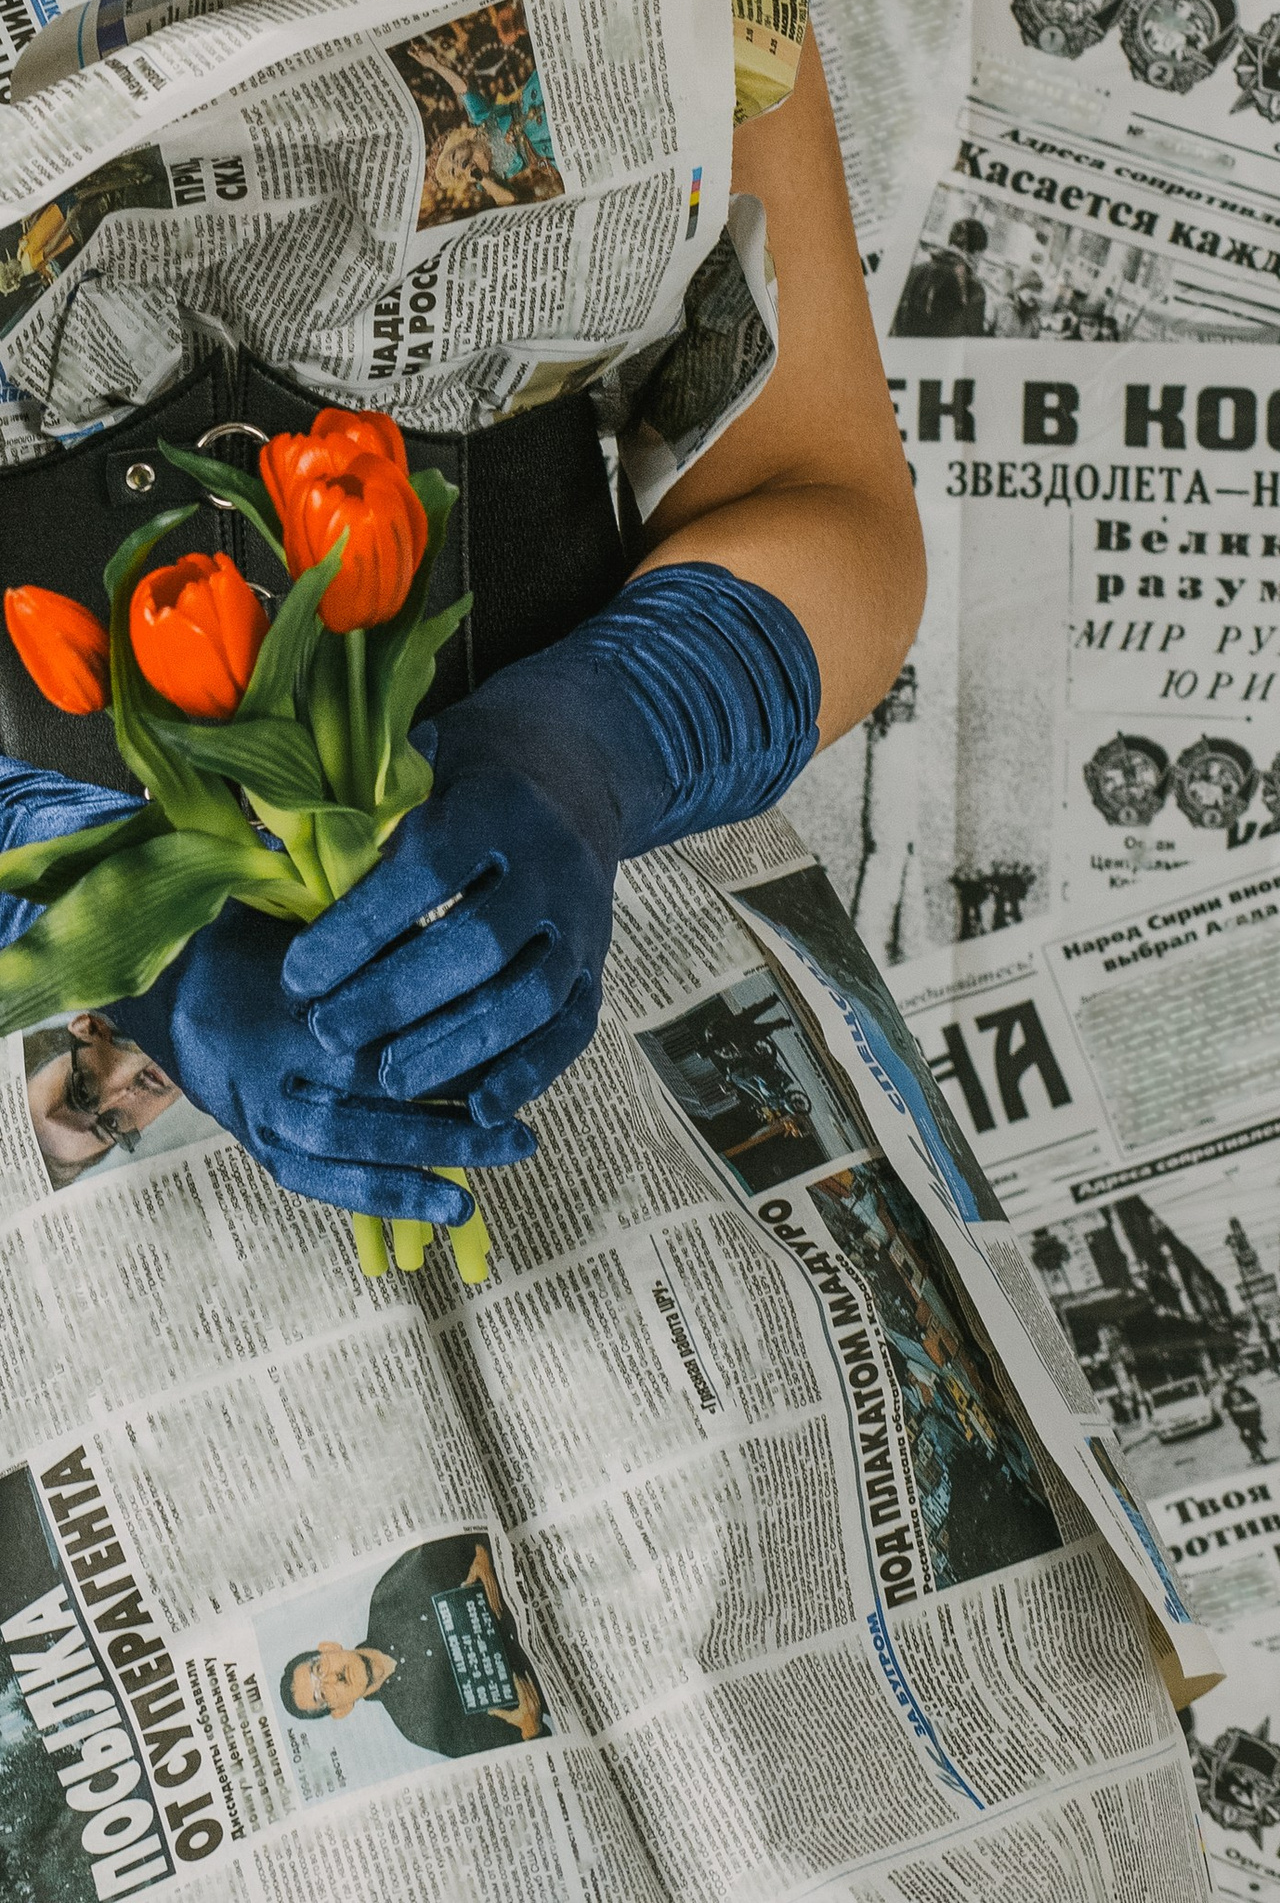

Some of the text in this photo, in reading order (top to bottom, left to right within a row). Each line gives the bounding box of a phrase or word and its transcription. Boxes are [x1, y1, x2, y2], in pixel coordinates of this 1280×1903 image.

[543, 69, 559, 121] Кадышева,
[660, 72, 675, 125] Советского
[1000, 125, 1104, 172] Адреса
[952, 140, 1161, 235] Касается
[488, 239, 500, 292] Малахова.
[499, 268, 509, 307] парень,
[509, 229, 521, 290] Вот одной
[441, 279, 455, 333] Кадышева
[454, 282, 465, 317] сейчас
[463, 301, 474, 333] Новый
[1023, 382, 1079, 446] В
[1073, 621, 1186, 653] МИР
[1062, 901, 1222, 961] Народ Сирии
[1104, 931, 1197, 973] выбрал
[757, 1197, 859, 1327] МАДУРО
[668, 1309, 696, 1358] работа
[871, 1339, 905, 1432] обстановку
[834, 1326, 907, 1527] ПЛАКАТОМ
[894, 1435, 917, 1505] описала
[1165, 1482, 1272, 1526] Твоя
[872, 1524, 923, 1609] ПОД
[909, 1508, 934, 1594] Россиянка
[41, 1446, 224, 1863] ОТ СУПЕРАГЕНТА
[867, 1612, 909, 1707] БУГРОМ
[203, 1656, 244, 1771] Центральному
[246, 1673, 265, 1712] США
[1, 1584, 176, 1900] ПОСЫЛКА
[185, 1659, 245, 1840] Диссиденты «объявили
[224, 1660, 276, 1823] разведывательному
